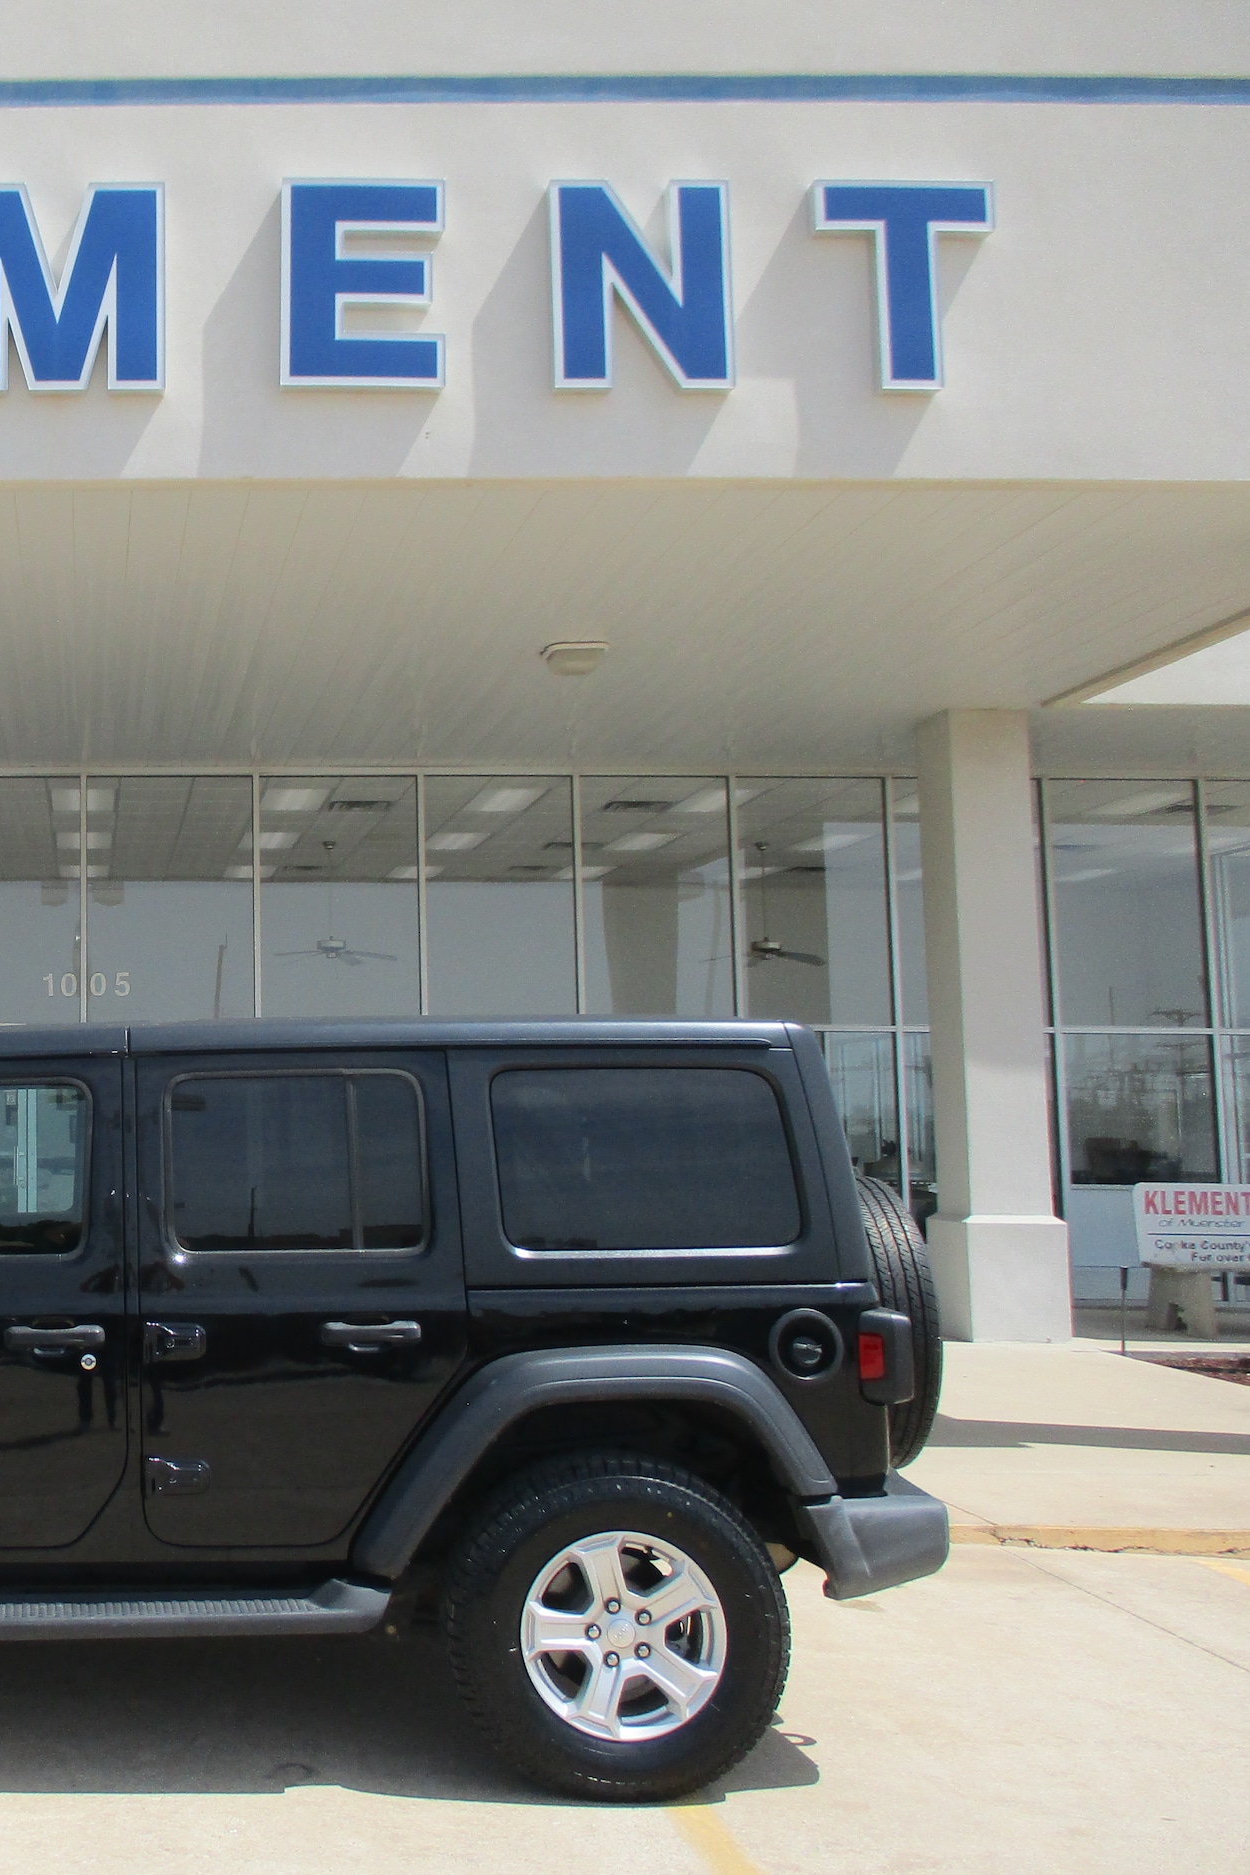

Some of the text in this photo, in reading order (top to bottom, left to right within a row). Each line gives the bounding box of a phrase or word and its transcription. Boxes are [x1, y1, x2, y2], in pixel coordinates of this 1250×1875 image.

[42, 971, 131, 997] 1005
[1144, 1190, 1250, 1216] KLEMENT
[1154, 1239, 1250, 1253] Coke County'
[1191, 1251, 1212, 1262] For
[1216, 1254, 1245, 1263] over
